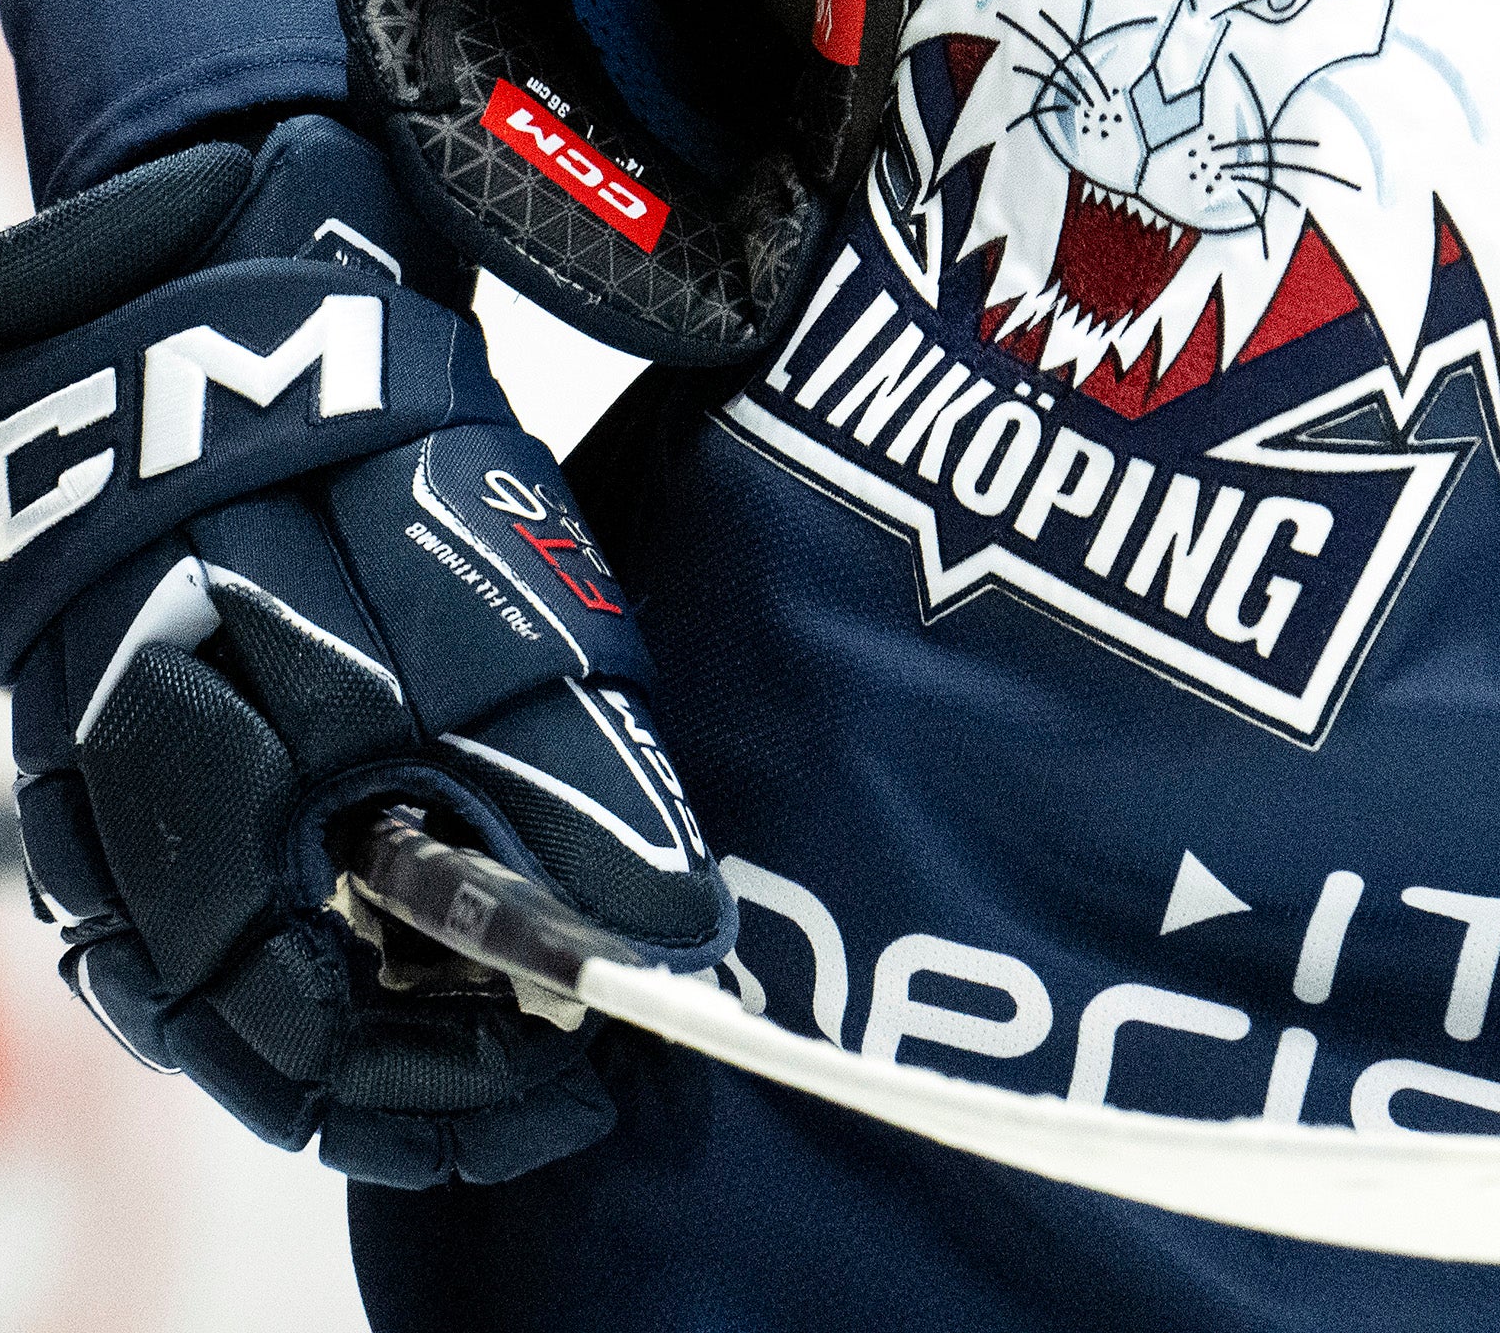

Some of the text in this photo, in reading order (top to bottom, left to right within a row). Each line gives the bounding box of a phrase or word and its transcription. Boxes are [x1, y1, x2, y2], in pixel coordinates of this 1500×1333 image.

[506, 107, 648, 220] CCM
[768, 243, 1334, 659] LINKÖPING
[598, 689, 706, 859] CCM
